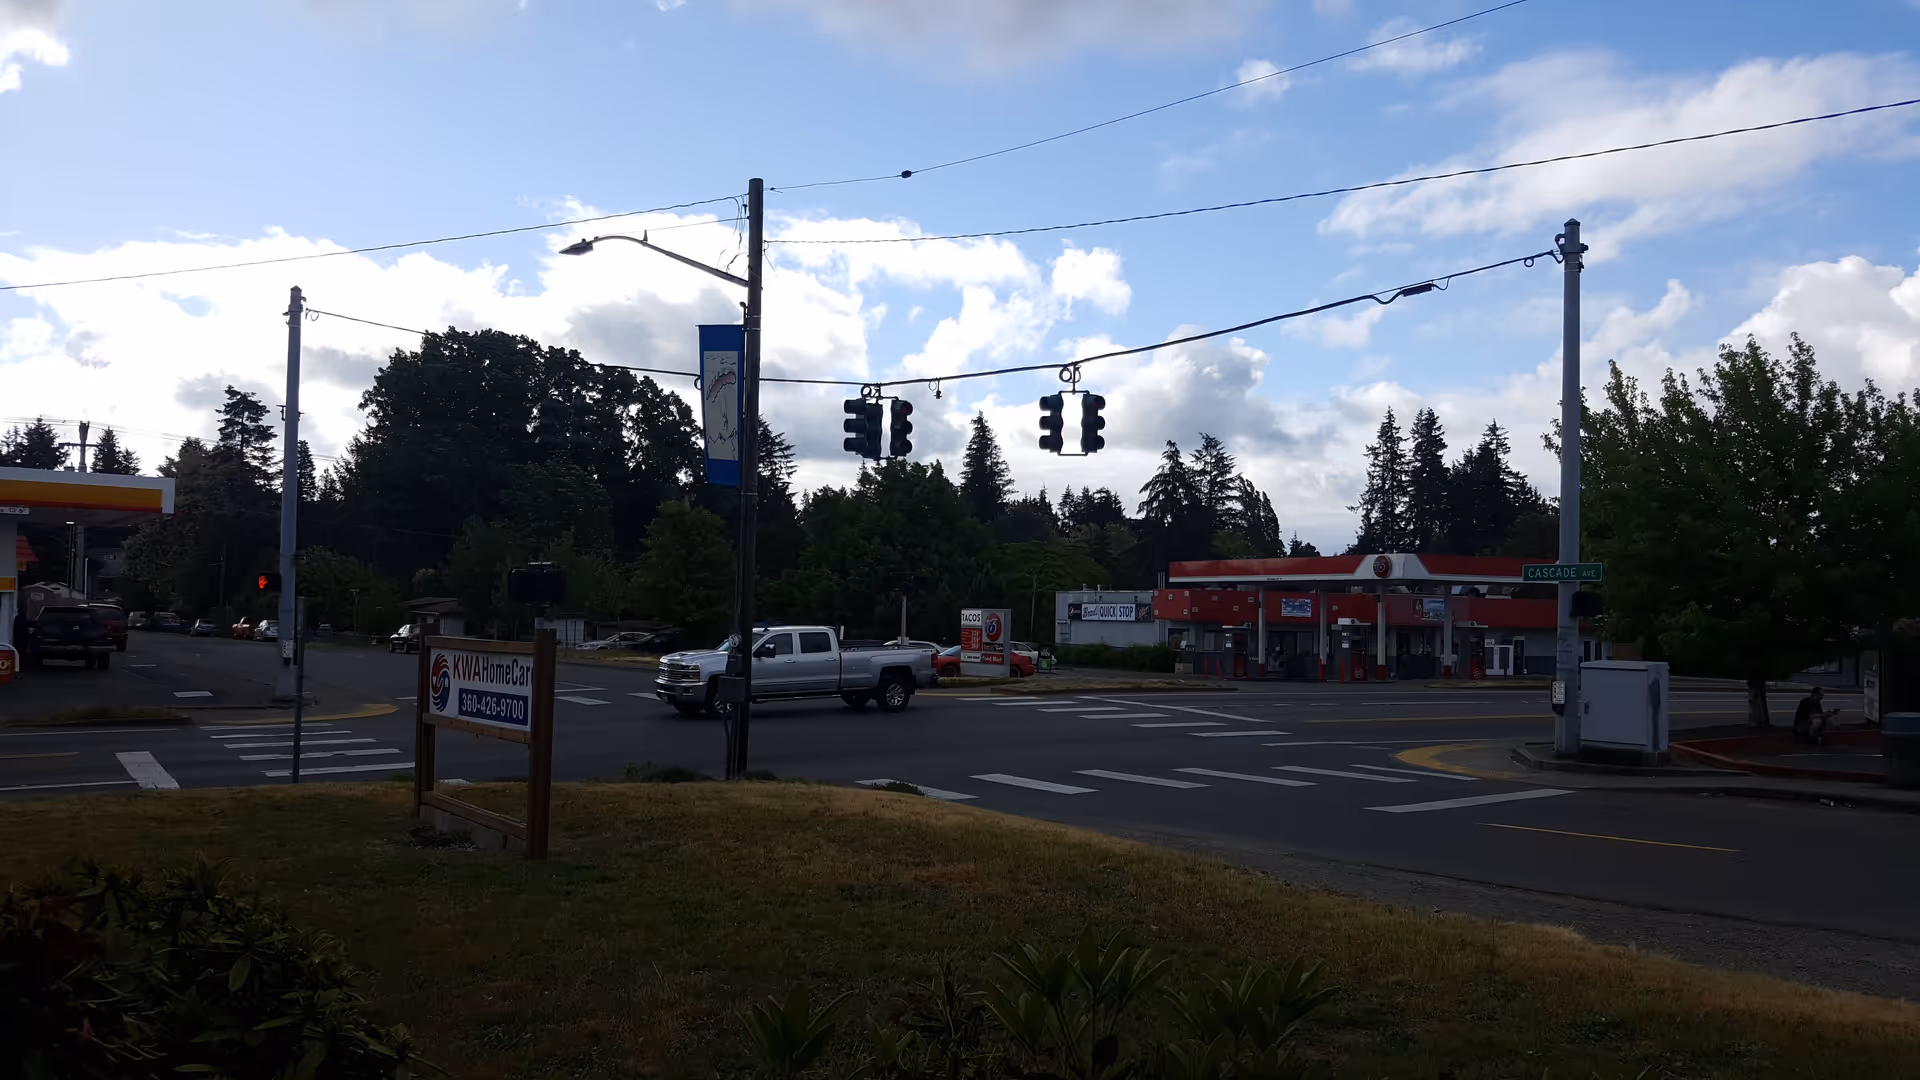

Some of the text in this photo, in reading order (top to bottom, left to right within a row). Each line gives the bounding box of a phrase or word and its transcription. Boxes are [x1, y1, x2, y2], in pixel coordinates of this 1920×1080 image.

[1528, 567, 1596, 578] CASCADE AVE
[962, 613, 981, 622] TACOS
[1100, 606, 1116, 618] QUICK
[1119, 605, 1134, 618] STOP
[453, 654, 534, 687] KWAHomeCar
[462, 693, 524, 720] 360-426-9700
